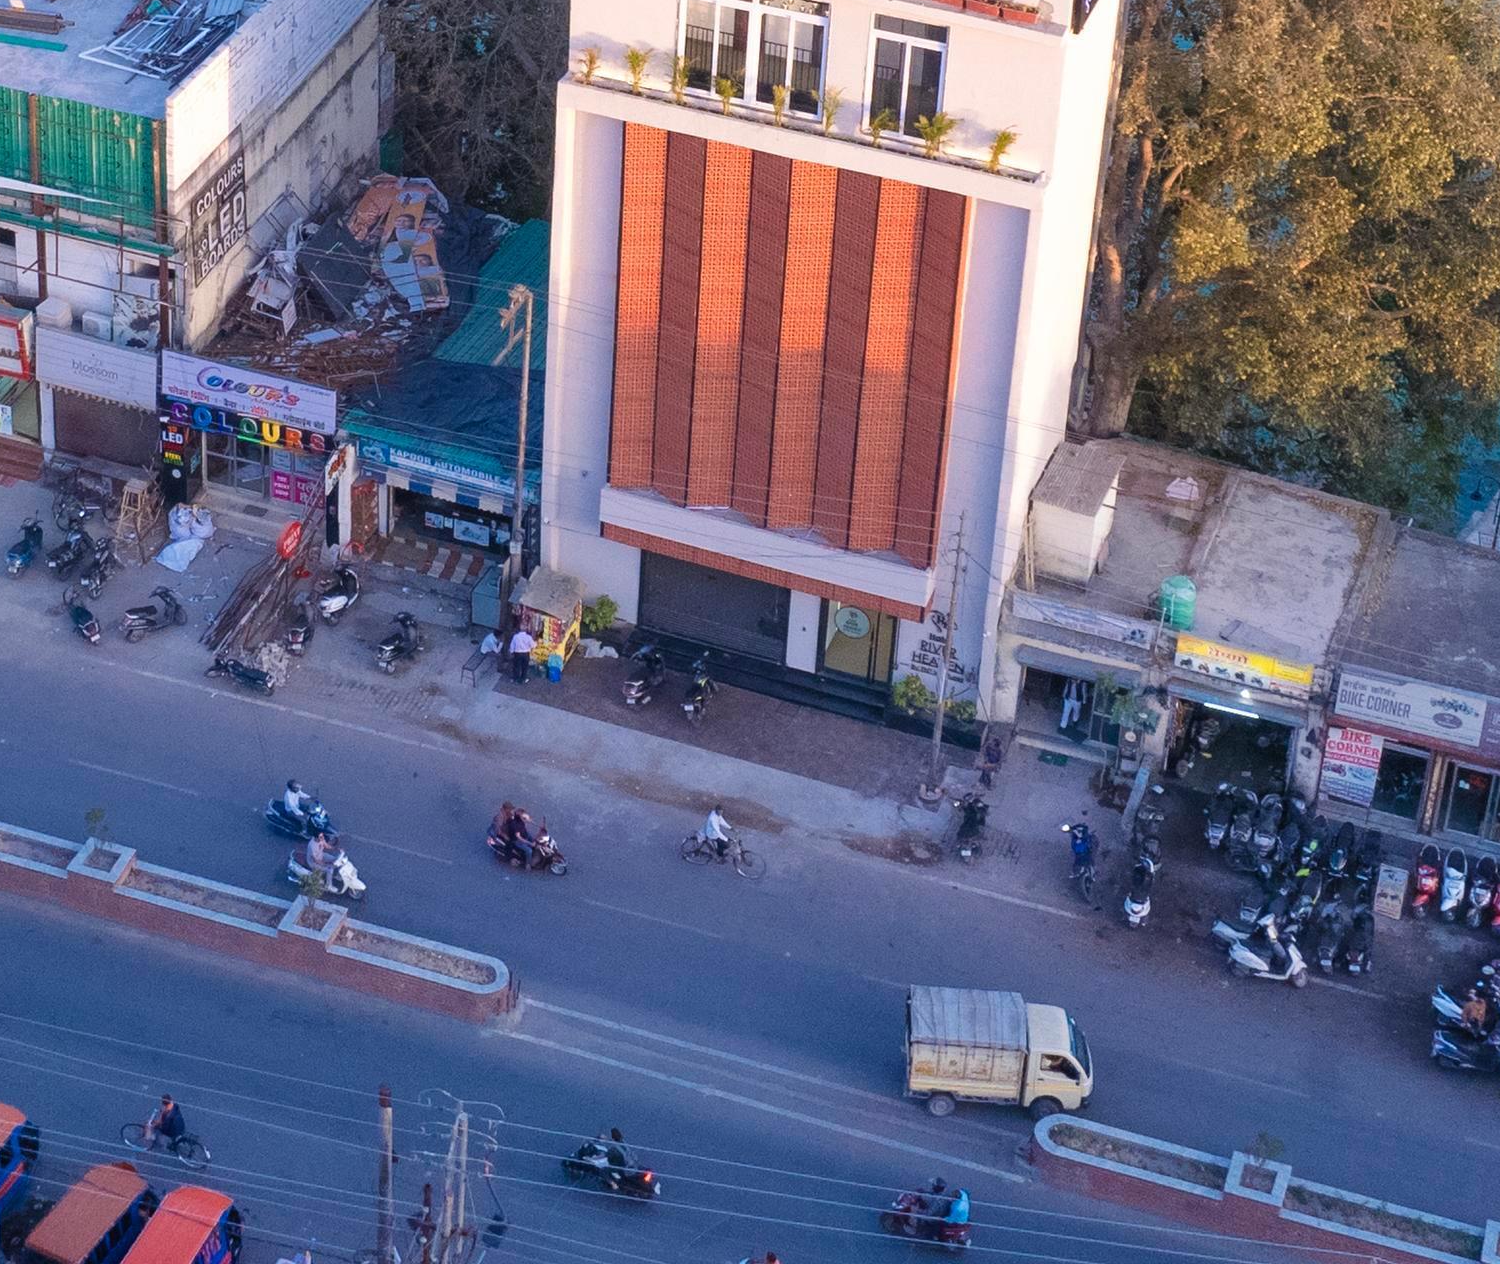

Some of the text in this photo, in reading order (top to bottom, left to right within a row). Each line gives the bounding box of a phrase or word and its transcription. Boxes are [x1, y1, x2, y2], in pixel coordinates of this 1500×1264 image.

[72, 359, 118, 380] blossom
[162, 430, 183, 444] LED
[171, 402, 325, 454] COLOURS
[390, 447, 431, 466] KAPOOR
[921, 640, 958, 660] RIVR
[911, 651, 965, 675] HEAEN
[1340, 689, 1364, 708] BIKE
[1366, 694, 1411, 719] CORNER
[1342, 729, 1372, 745] BIKE
[1328, 740, 1380, 758] CORNER
